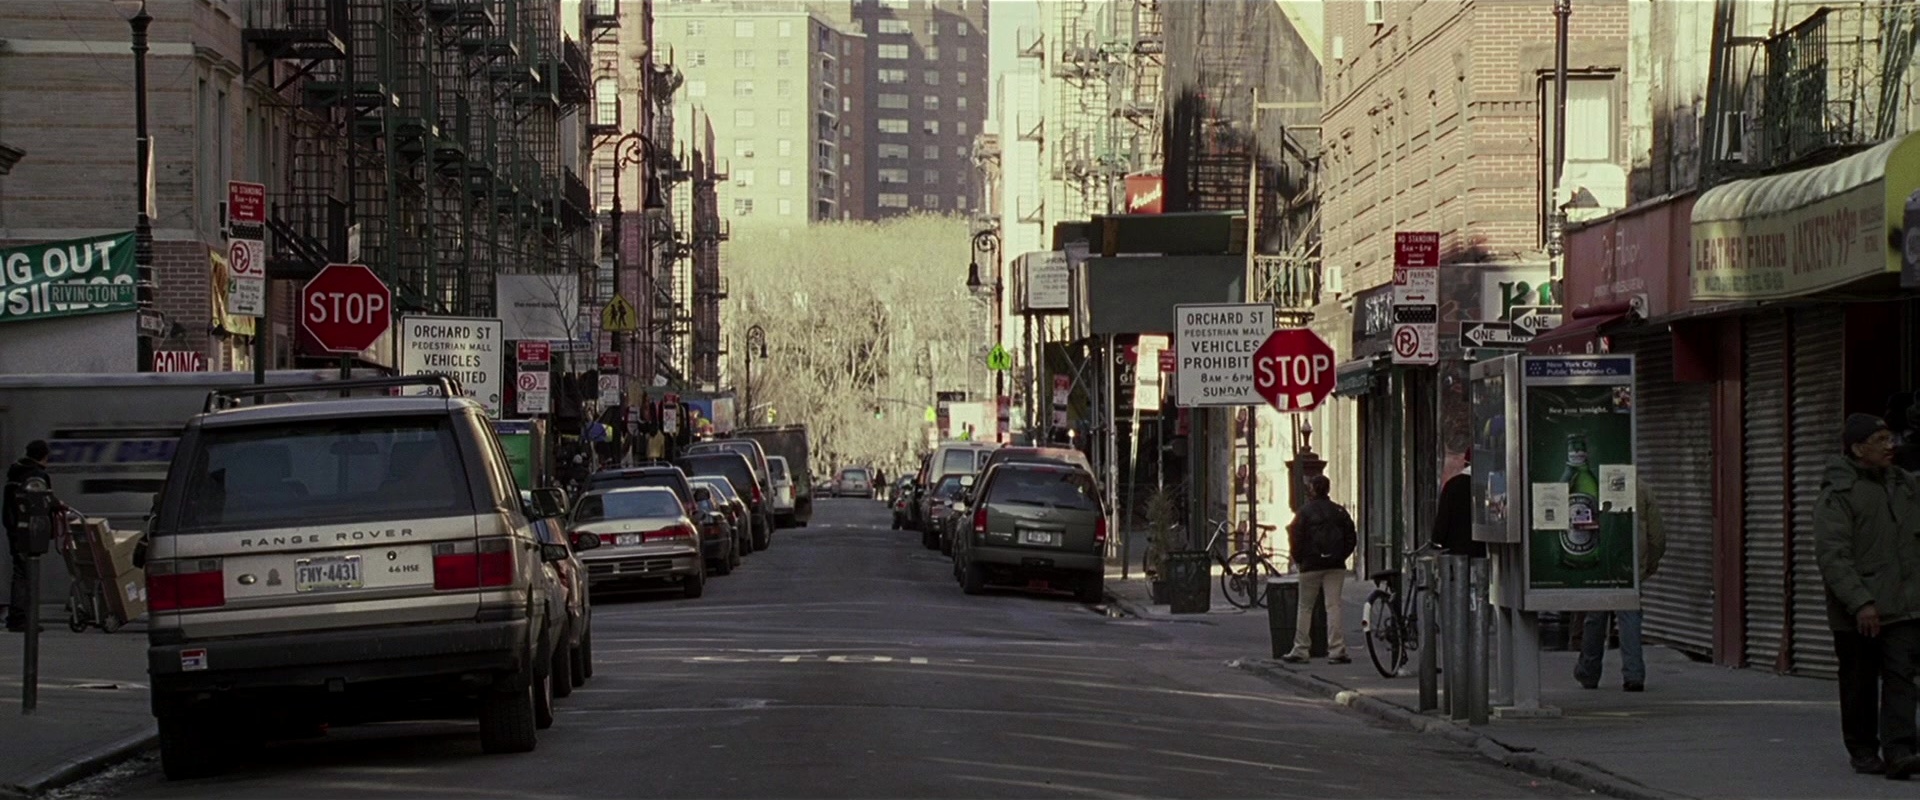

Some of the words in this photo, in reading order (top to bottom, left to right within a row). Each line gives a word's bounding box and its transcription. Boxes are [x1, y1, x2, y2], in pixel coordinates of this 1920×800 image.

[1397, 235, 1406, 243] NO
[1408, 235, 1437, 244] STANDING
[1695, 236, 1744, 271] LEATHER
[1746, 233, 1786, 269] FRIEND
[42, 240, 116, 278] OUT
[1394, 269, 1407, 285] NO
[1409, 271, 1434, 279] PARKING
[51, 286, 118, 302] RIVINGTON
[309, 291, 384, 324] STOP
[1187, 312, 1243, 325] ORCHARD
[1250, 311, 1264, 324] ST
[1523, 316, 1549, 328] ONE
[414, 325, 471, 339] ORCHARD
[476, 327, 491, 340] ST
[1184, 329, 1239, 338] PEDESTRIAN
[1242, 328, 1265, 336] MALL
[1473, 330, 1496, 341] ONE
[412, 341, 466, 350] PEDESTRIAN
[469, 343, 492, 352] MALL
[1191, 340, 1260, 353] VEHICLES
[154, 351, 202, 372] GOING
[424, 353, 481, 368] VEHICLES
[1184, 356, 1250, 369] PROHIBIT
[1582, 361, 1597, 369] City
[1258, 354, 1330, 388] STOP
[1569, 368, 1604, 376] Telephone
[1203, 386, 1250, 397] SUNDAY
[241, 534, 320, 547] RANGE
[336, 528, 413, 541] ROVER
[403, 563, 419, 573] HSE
